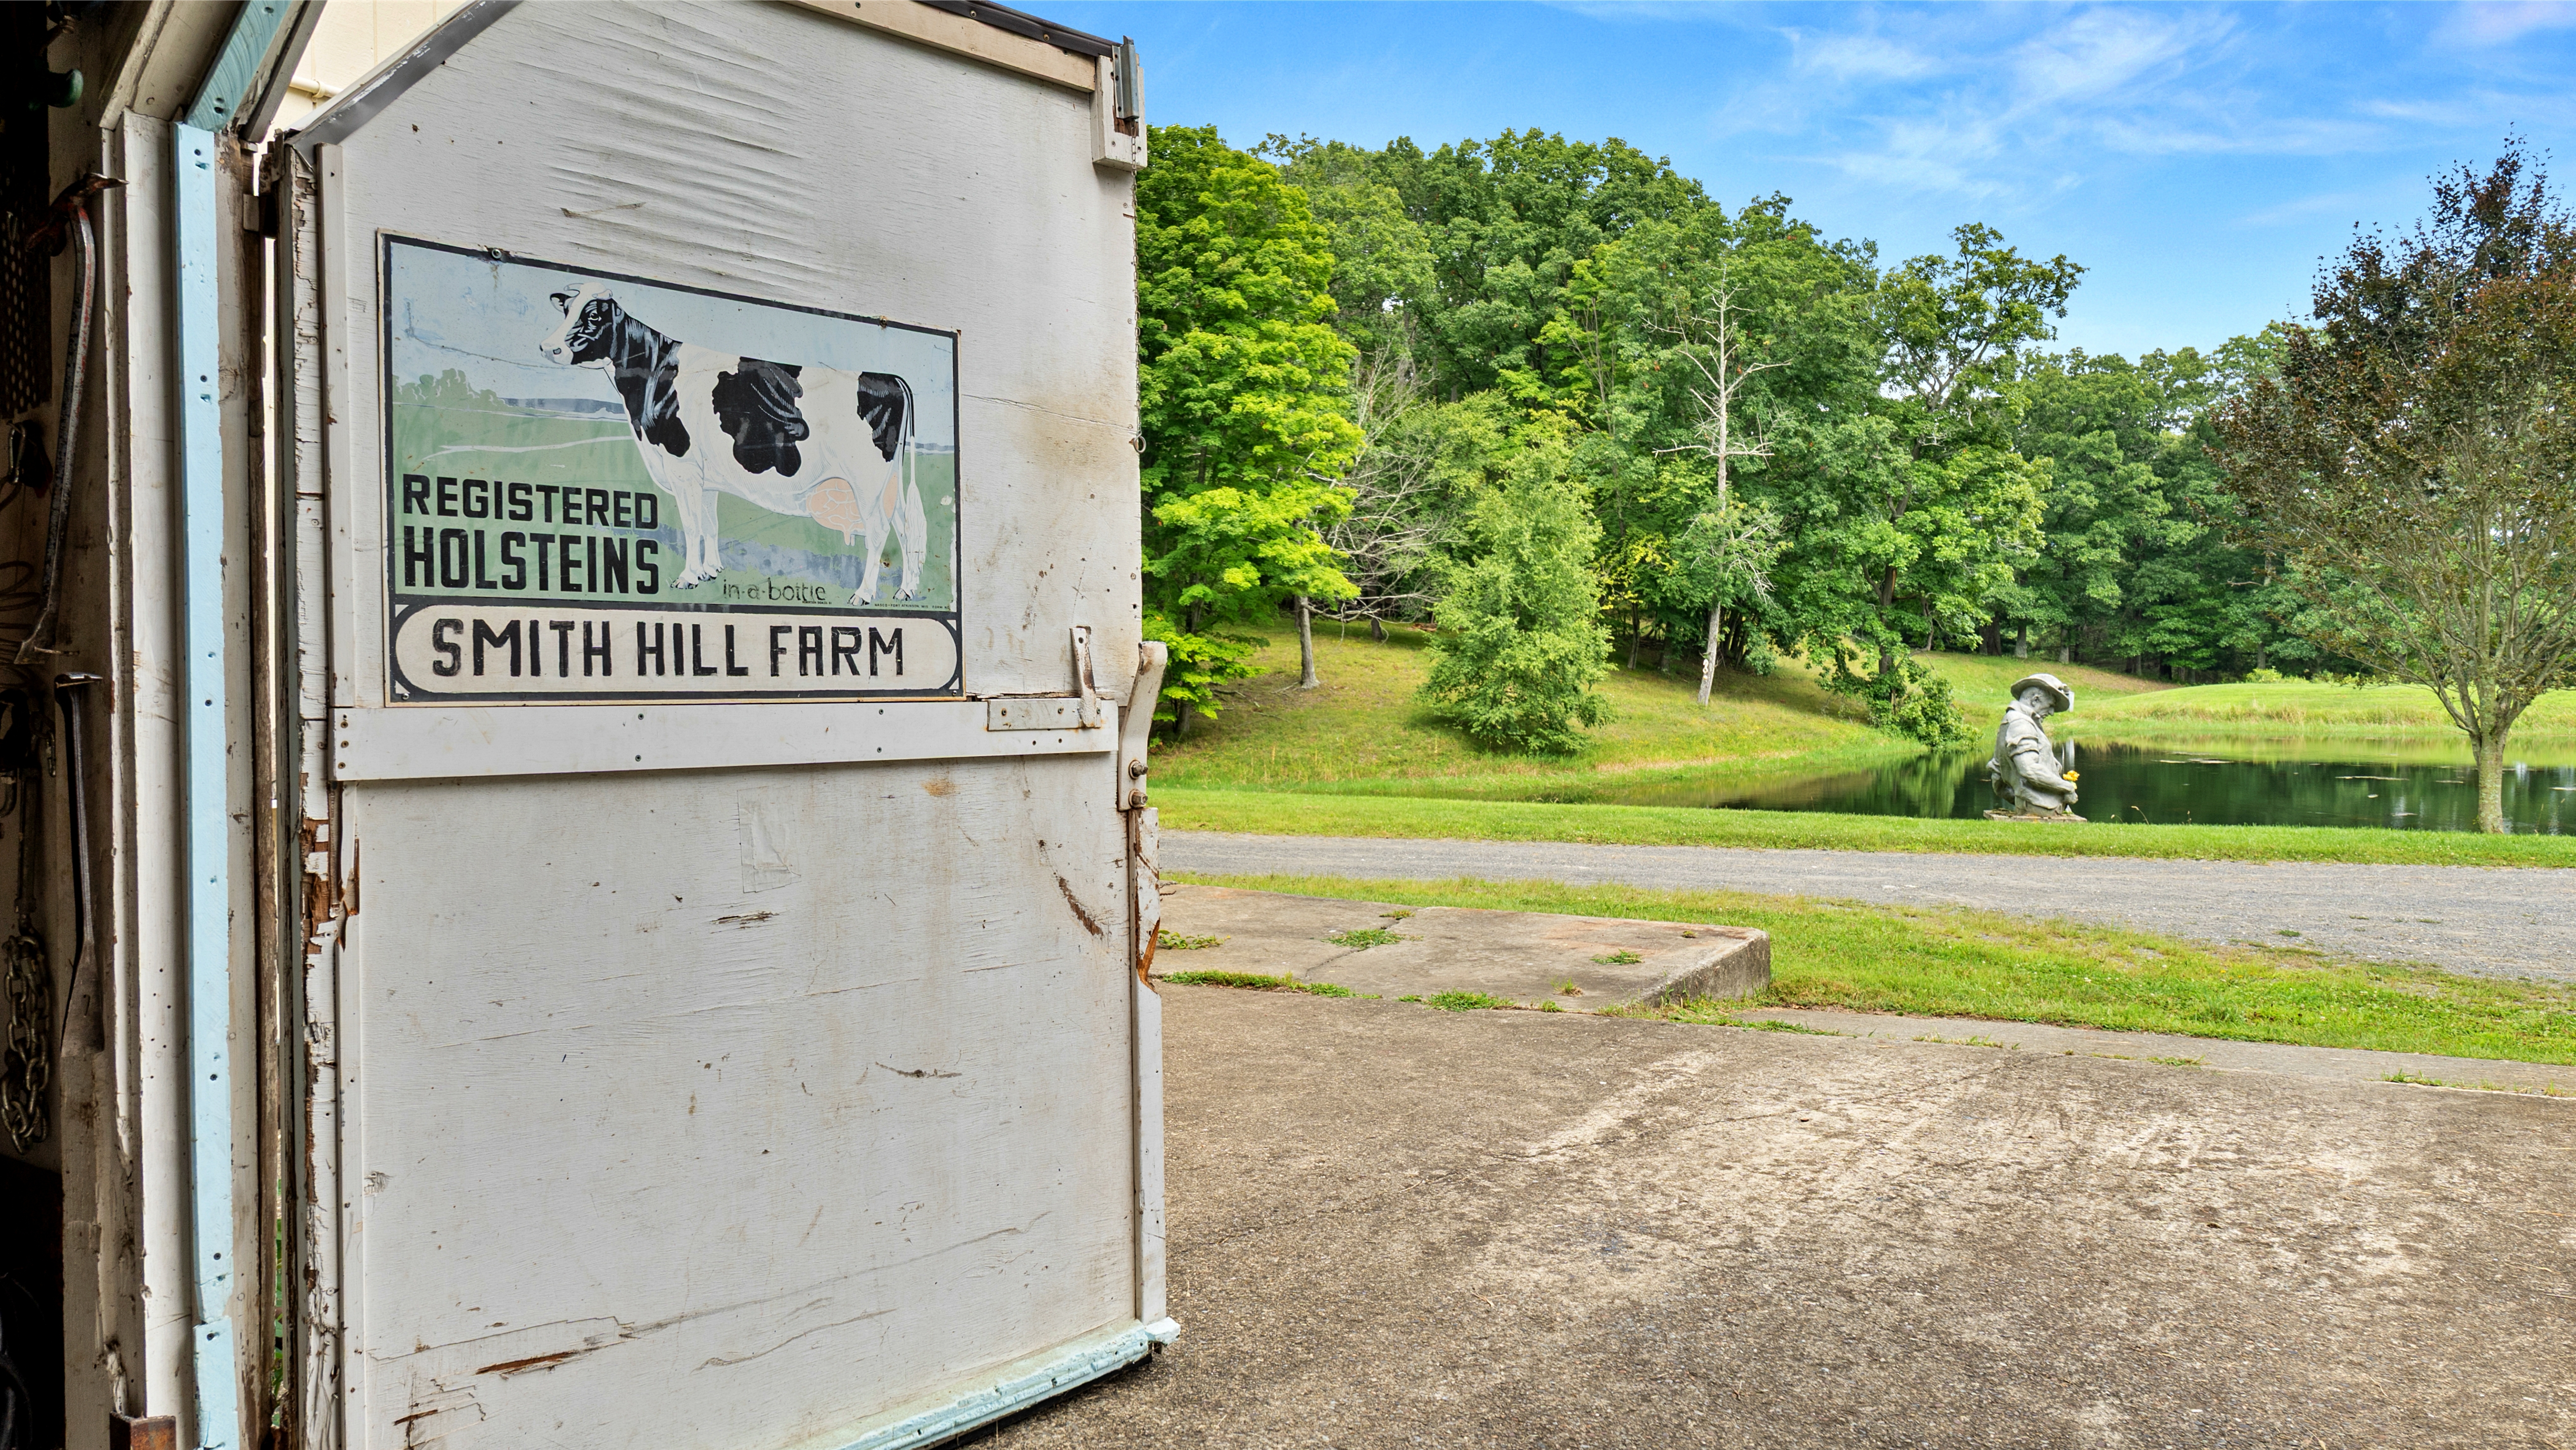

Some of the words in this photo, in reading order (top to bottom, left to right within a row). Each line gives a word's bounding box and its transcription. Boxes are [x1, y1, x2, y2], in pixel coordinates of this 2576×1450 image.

[403, 474, 658, 529] REGISTERED
[404, 526, 659, 594] HOLSTEINS
[433, 618, 612, 678] SMITH
[637, 621, 748, 676] HILL
[770, 625, 903, 677] FARM
